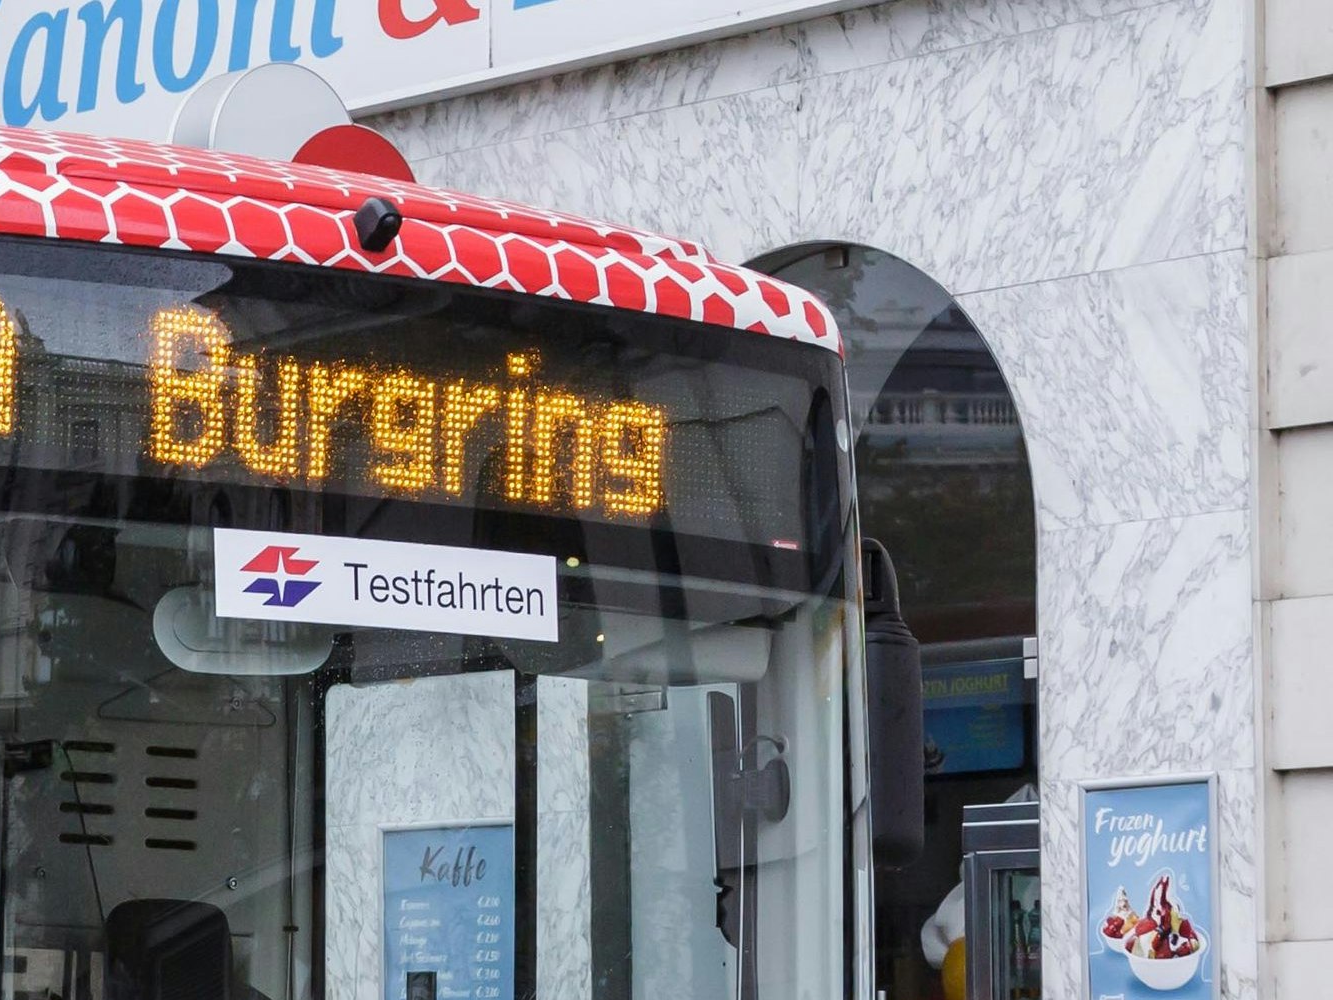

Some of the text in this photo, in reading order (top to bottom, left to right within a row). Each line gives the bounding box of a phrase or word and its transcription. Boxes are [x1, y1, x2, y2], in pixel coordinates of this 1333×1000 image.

[150, 306, 666, 517] Burgring
[344, 562, 547, 618] Testfahrten
[1095, 807, 1154, 834] Frozen
[1107, 819, 1207, 867] yoghurt
